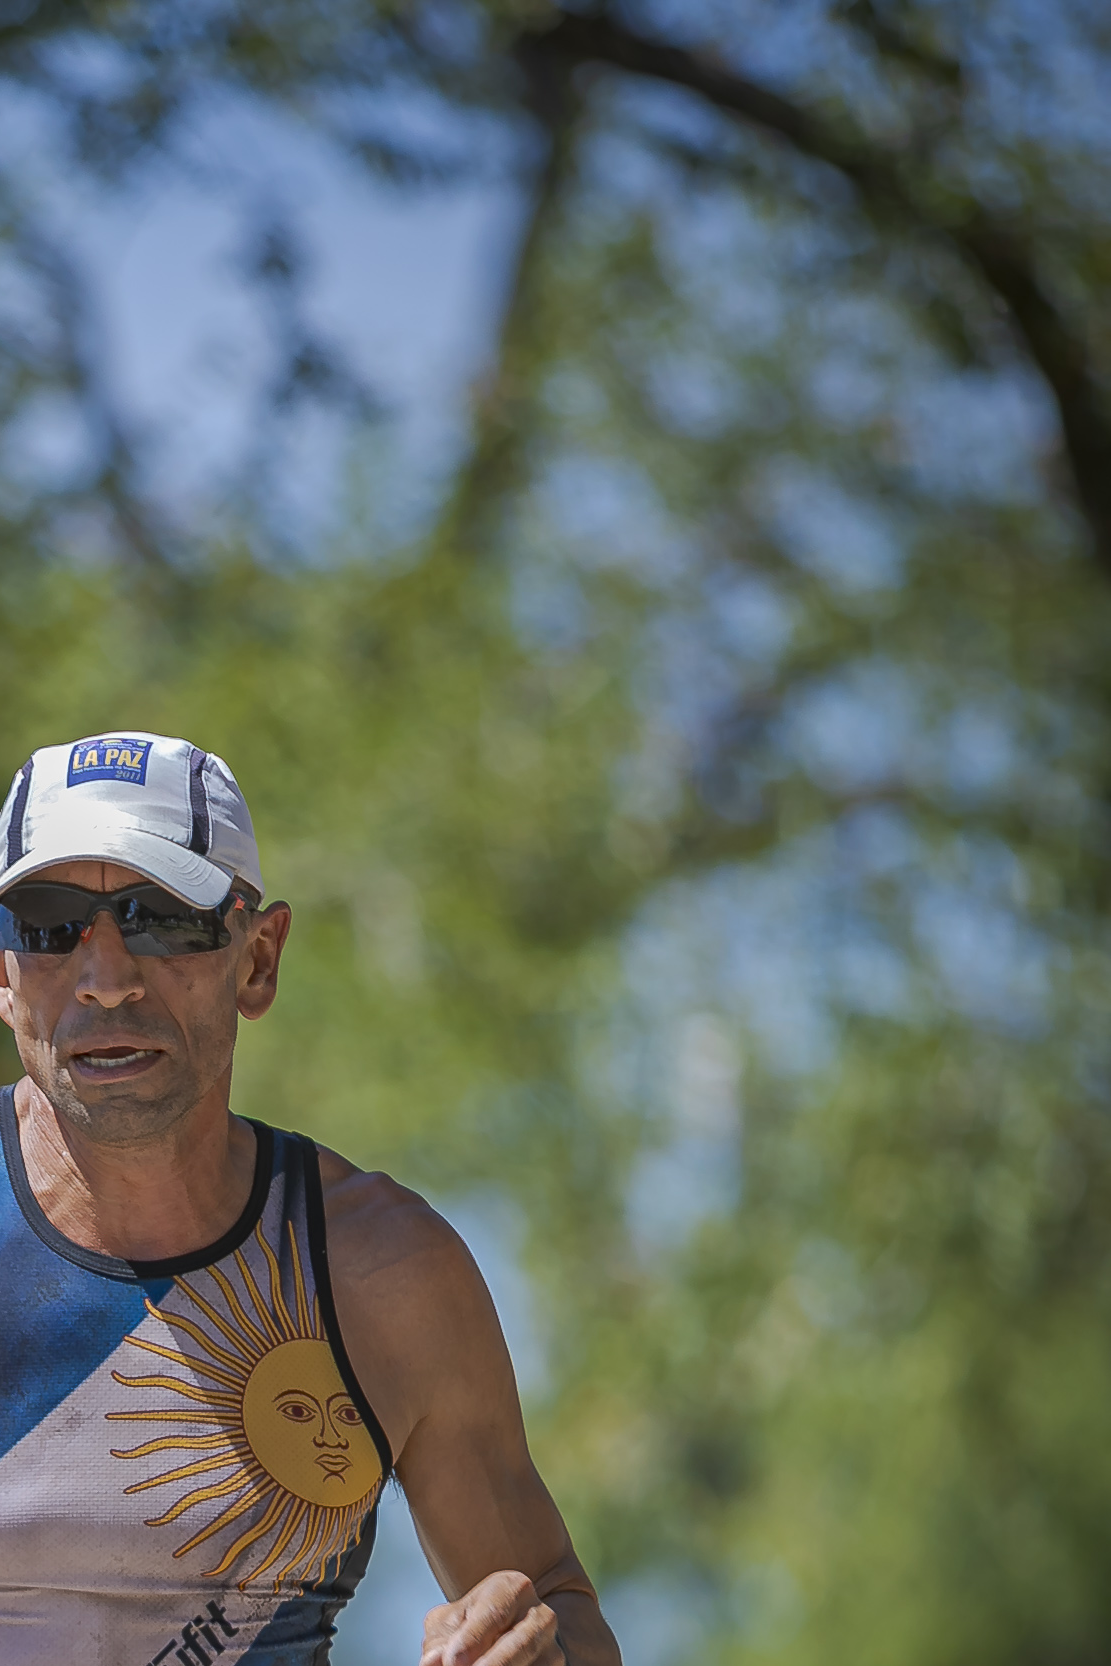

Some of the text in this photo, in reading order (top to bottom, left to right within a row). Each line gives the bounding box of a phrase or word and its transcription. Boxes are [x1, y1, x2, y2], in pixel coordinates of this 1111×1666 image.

[73, 751, 98, 770] LA
[104, 748, 144, 768] PAZ
[115, 770, 141, 781] 2011
